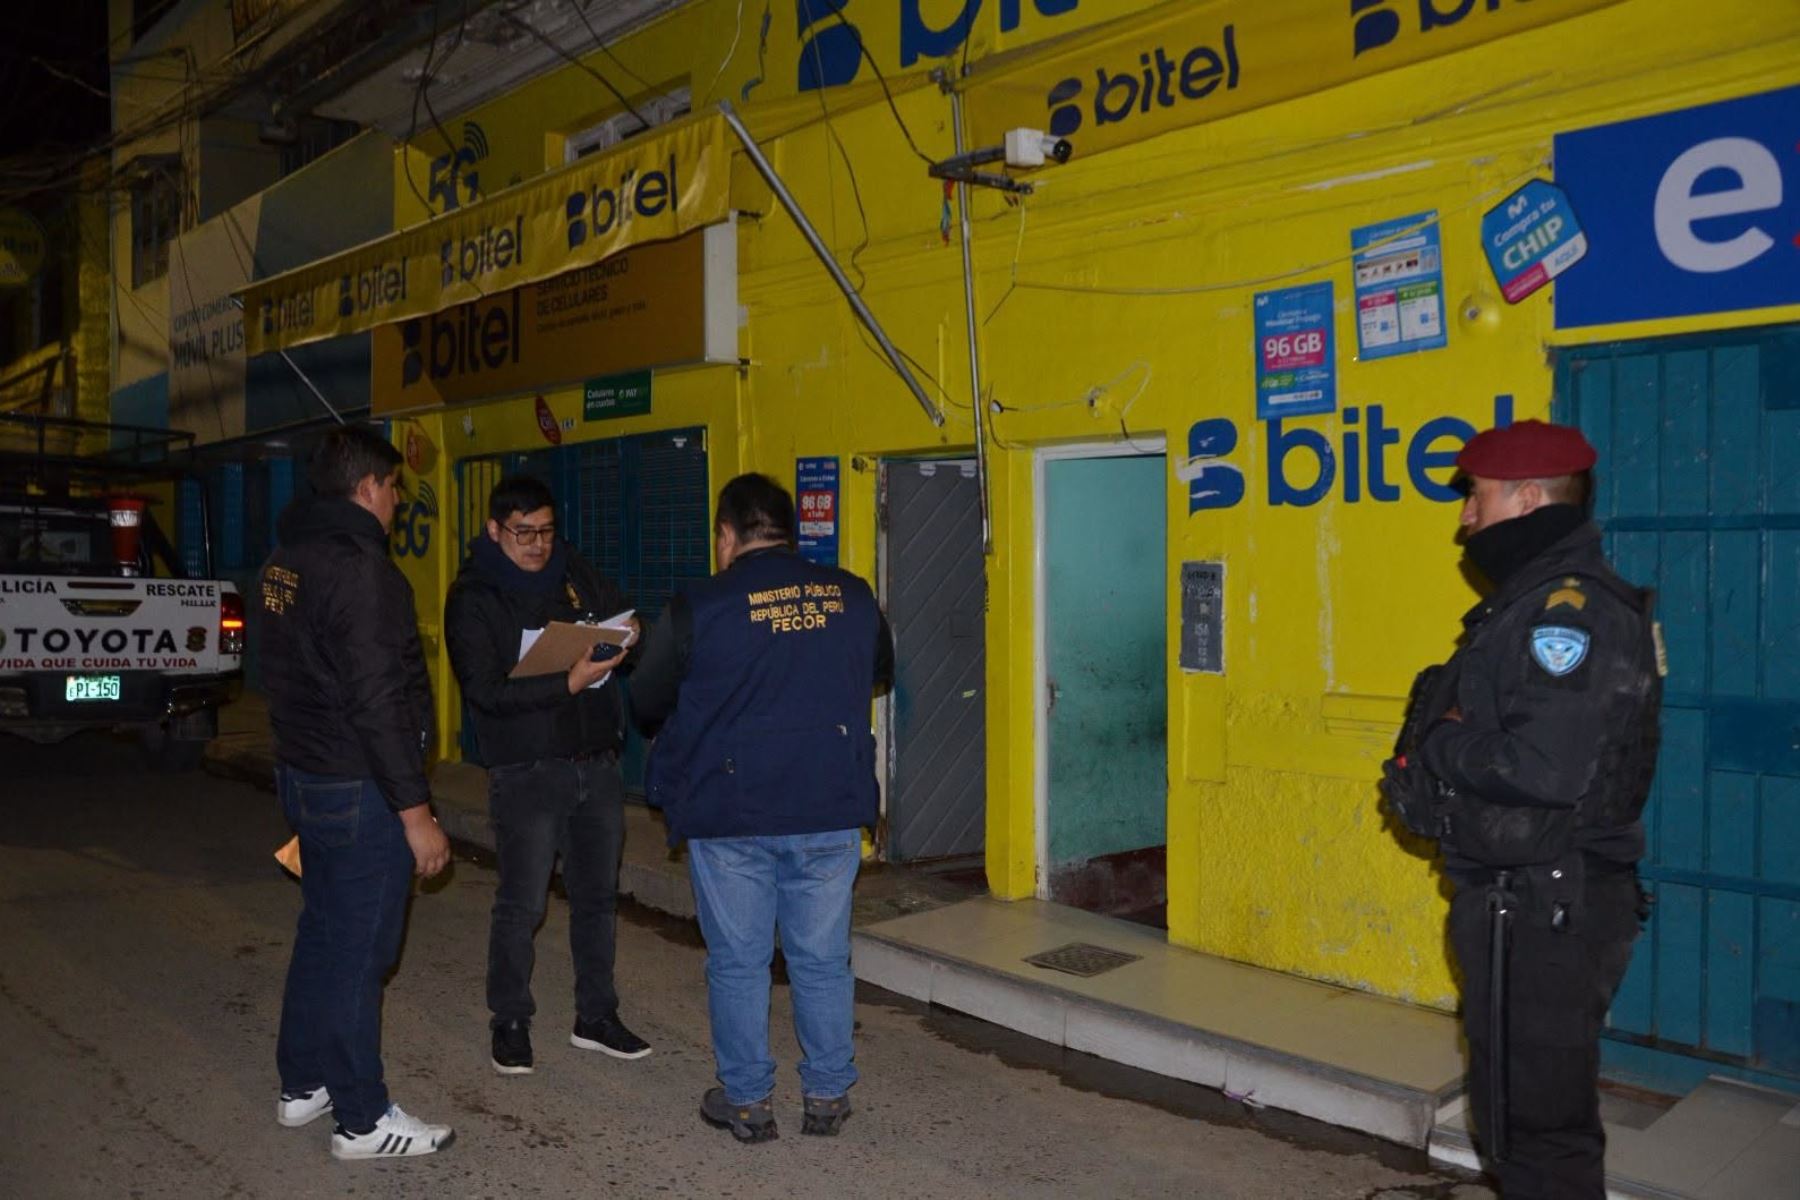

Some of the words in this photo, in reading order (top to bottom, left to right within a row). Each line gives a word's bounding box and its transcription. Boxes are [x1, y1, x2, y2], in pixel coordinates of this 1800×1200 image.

[1094, 24, 1239, 126] bitel
[591, 153, 678, 236] bitel
[1493, 209, 1540, 248] Compra
[1540, 198, 1556, 214] tu
[1502, 214, 1563, 271] CHIP
[460, 215, 523, 281] bitel
[357, 257, 408, 315] bitel
[275, 290, 315, 332] bitel
[537, 301, 550, 317] DE
[212, 319, 243, 358] PLUS
[429, 288, 520, 380] bitel
[1265, 337, 1290, 359] 96
[1294, 332, 1322, 354] GB
[802, 495, 816, 511] 96
[817, 494, 832, 510] GB
[395, 500, 430, 558] 5G
[0, 578, 57, 594] LICÍA
[146, 584, 215, 598] RESCATE
[748, 585, 801, 606] MINISTERIO
[804, 582, 842, 598] PÚBLICO
[750, 603, 799, 623] REPÚBLICA
[802, 601, 819, 615] DEL
[822, 598, 844, 614] PERÚ
[771, 615, 826, 634] FECOR
[14, 629, 177, 653] TOYOTA
[0, 658, 36, 668] VIDA
[41, 658, 76, 669] QUE
[82, 658, 131, 668] CUIDA
[136, 658, 158, 668] TU
[162, 658, 197, 668] VIDA
